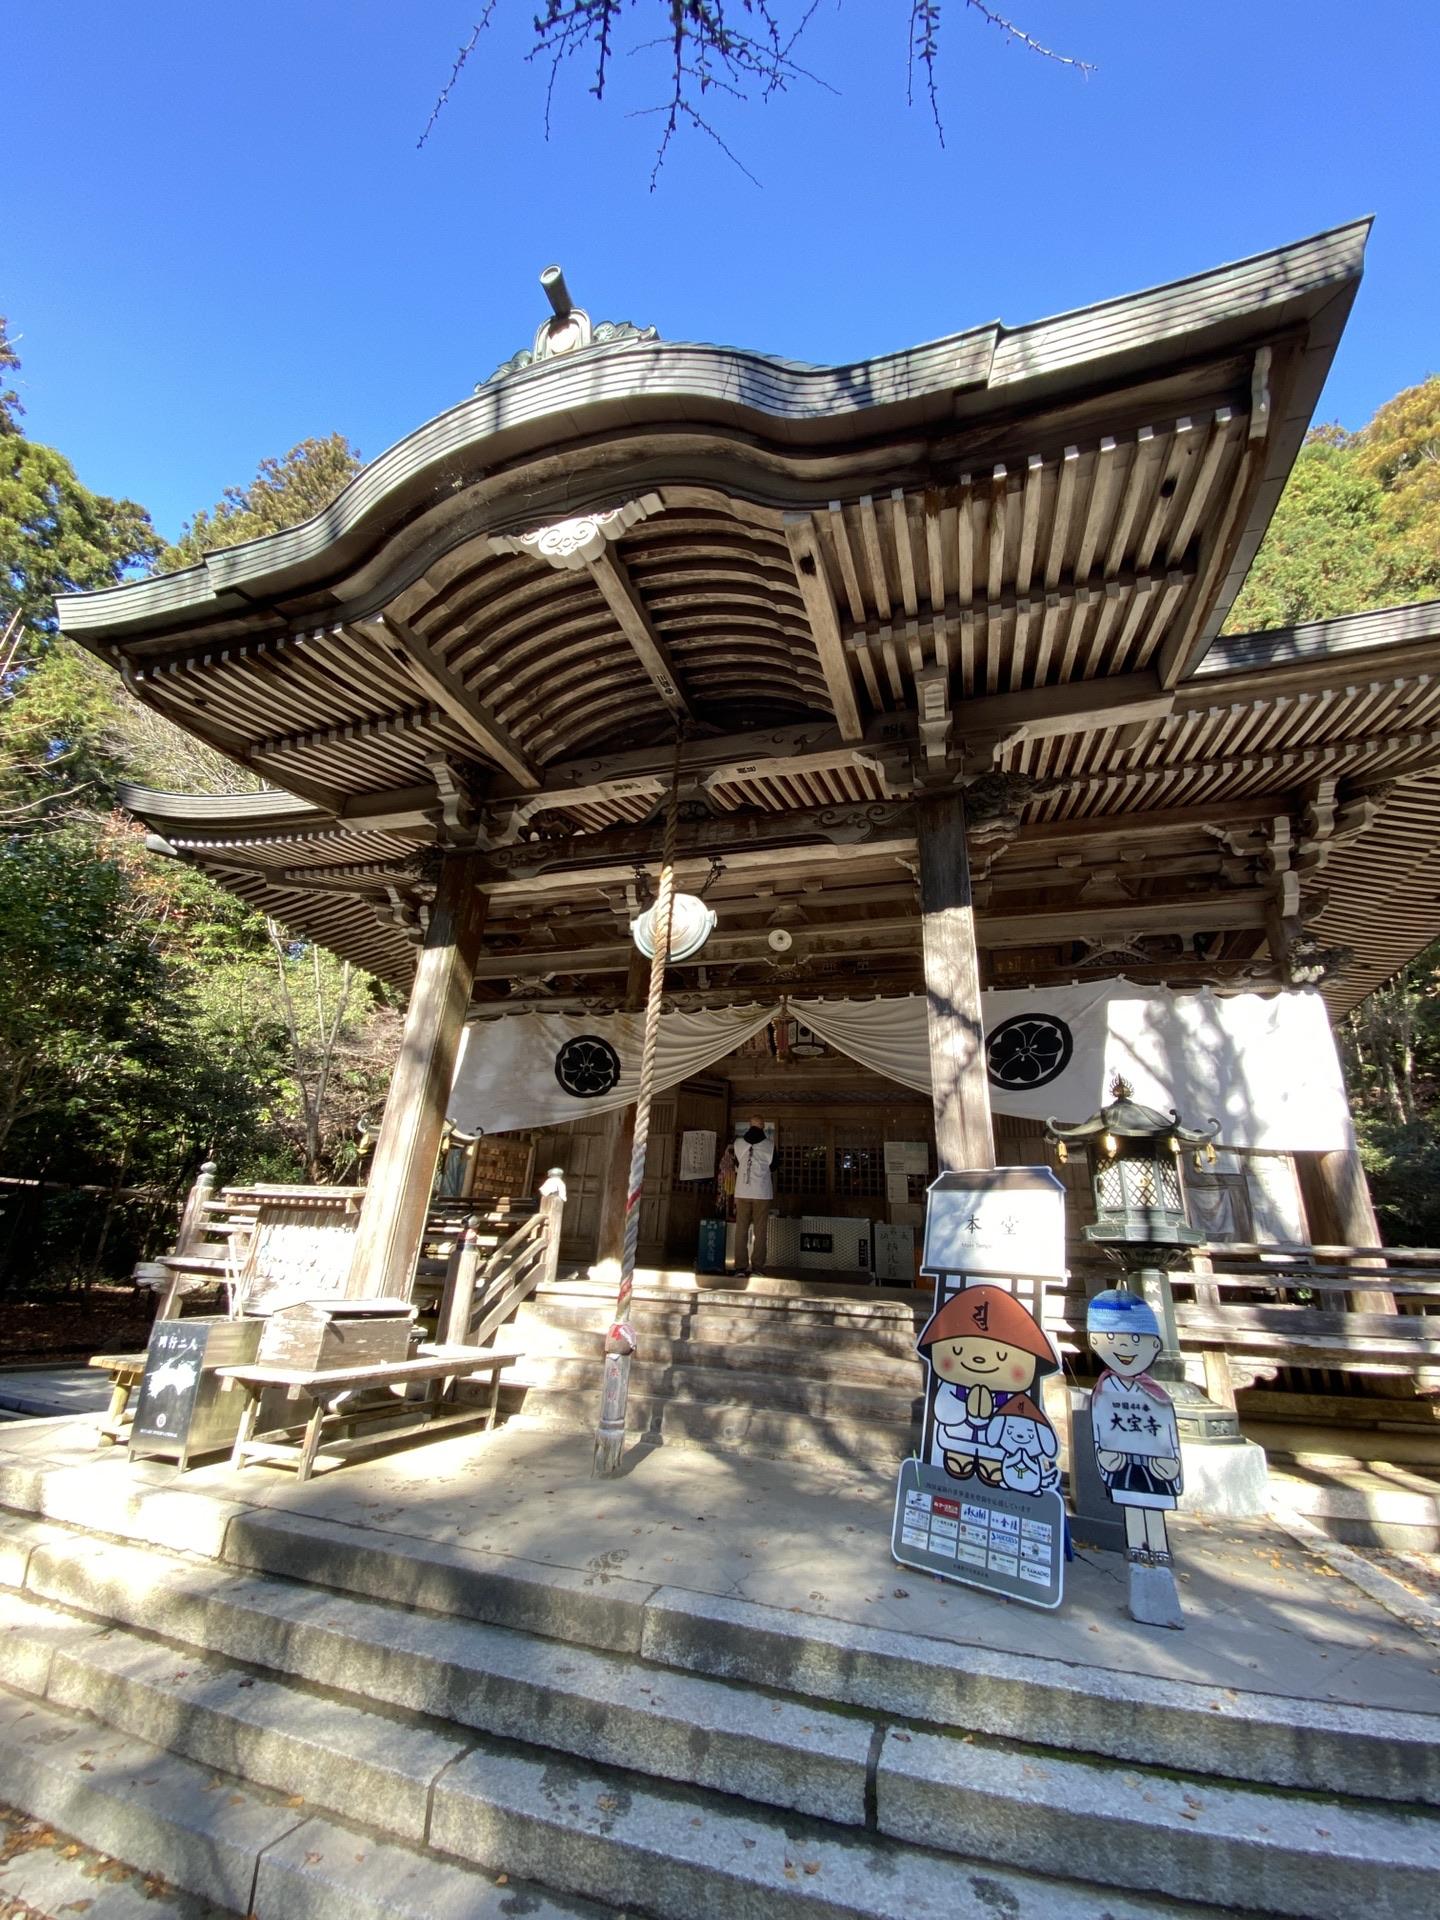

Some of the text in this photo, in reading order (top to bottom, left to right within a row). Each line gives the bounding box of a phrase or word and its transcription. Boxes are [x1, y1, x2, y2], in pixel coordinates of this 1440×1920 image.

[965, 1214, 1020, 1235] 本堂
[158, 1335, 198, 1351] 同行二人
[1112, 1402, 1151, 1412] 四国44番
[1110, 1412, 1162, 1437] 大宝寺
[963, 1505, 987, 1520] Asahi
